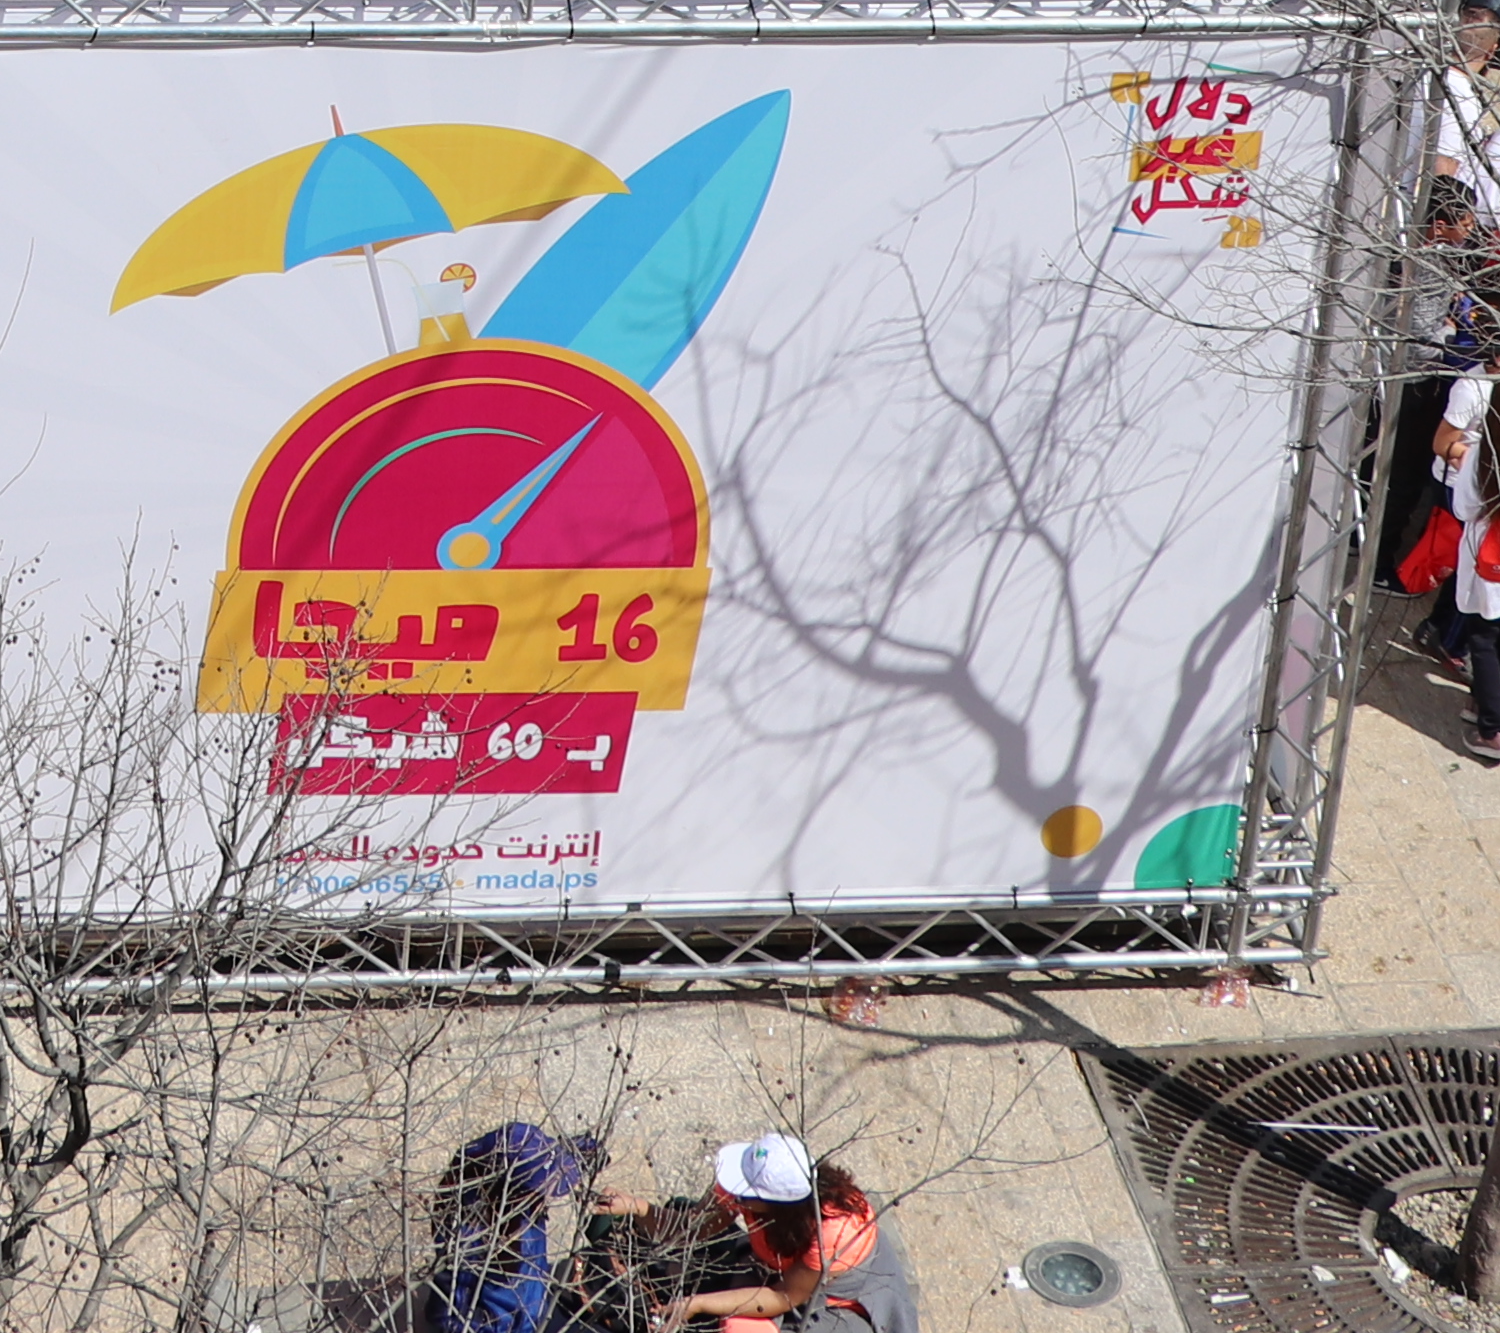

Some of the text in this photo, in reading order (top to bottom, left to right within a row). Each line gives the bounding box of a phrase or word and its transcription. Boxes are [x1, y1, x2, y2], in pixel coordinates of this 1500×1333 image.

[1131, 163, 1250, 226] شكل
[556, 592, 659, 664] 16
[487, 722, 543, 762] 60
[474, 868, 599, 891] mada.ps
